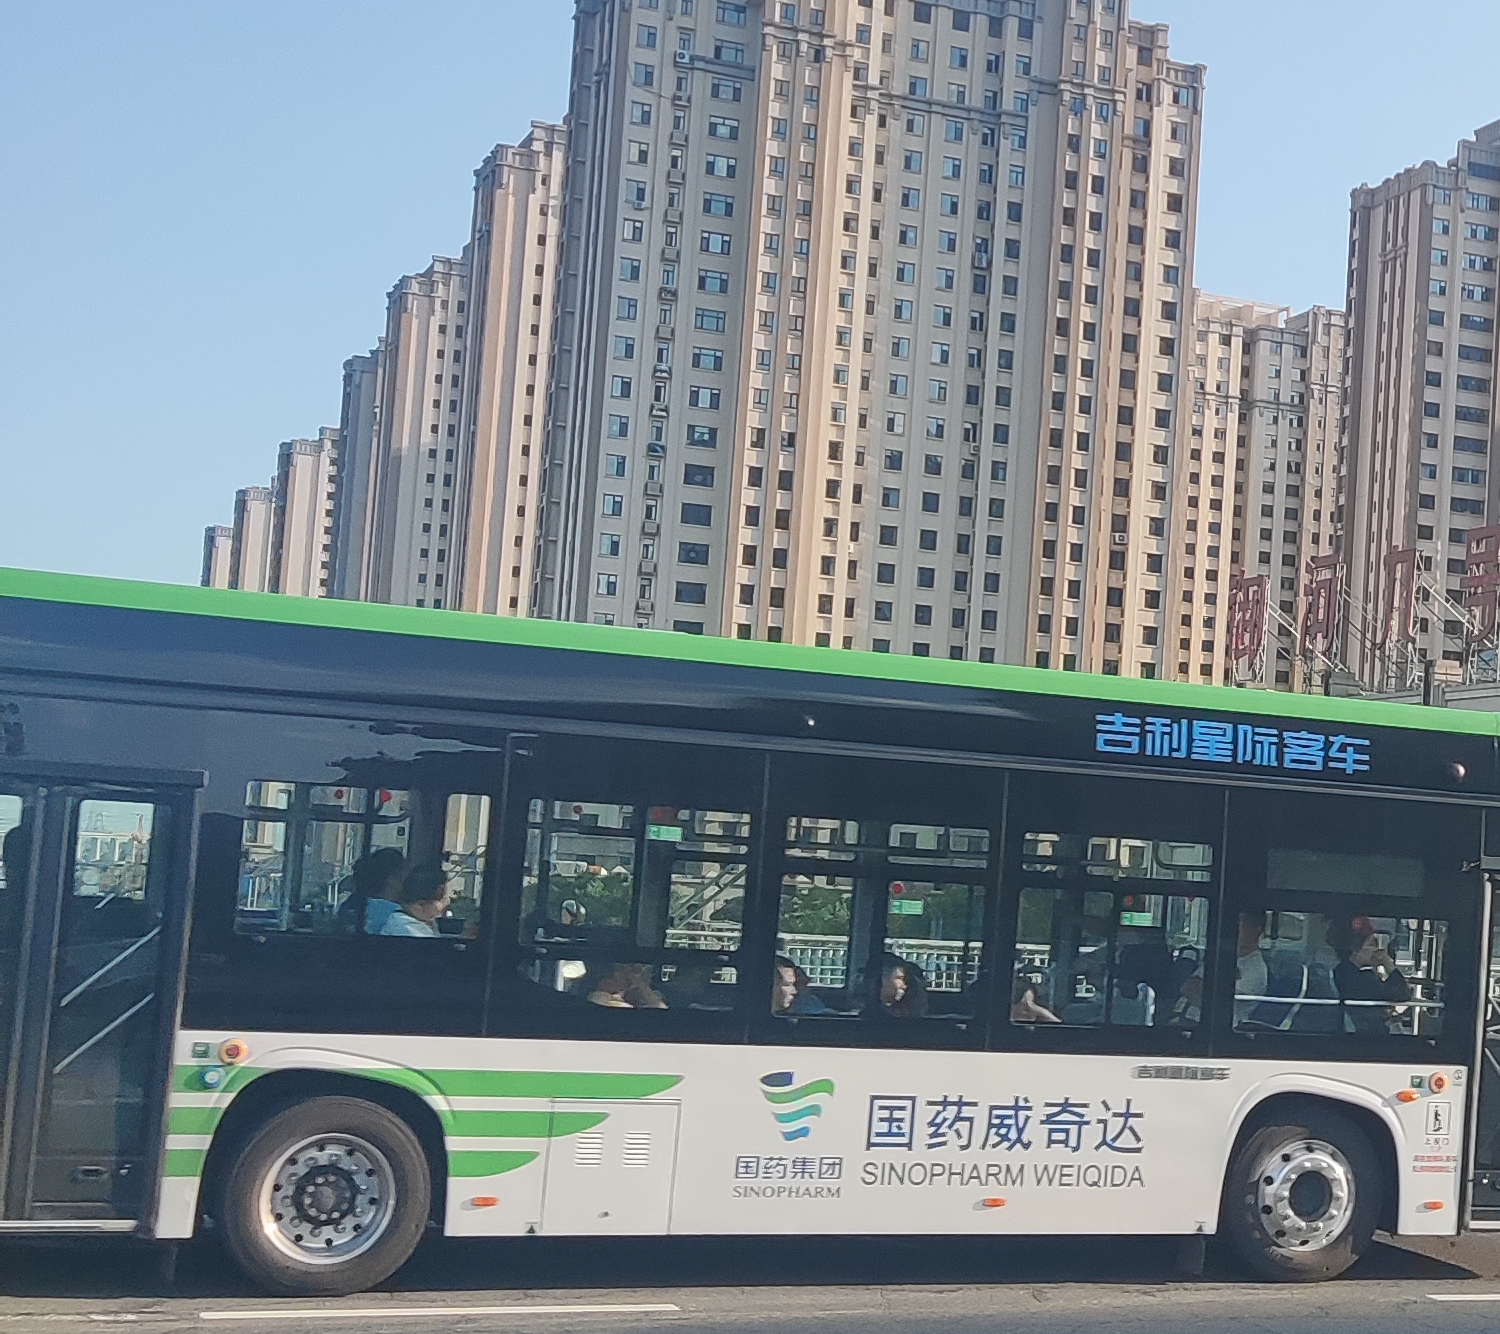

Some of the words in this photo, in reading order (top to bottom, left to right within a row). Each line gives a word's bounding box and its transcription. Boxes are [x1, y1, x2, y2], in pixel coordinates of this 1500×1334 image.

[1095, 712, 1371, 774] 吉利星际客车
[865, 1094, 1145, 1154] 国药威奇达
[735, 1155, 843, 1180] 国药集团
[861, 1161, 1026, 1188] SINOPHARM
[1033, 1163, 1146, 1189] WEIQIDA
[732, 1185, 841, 1199] SINOPHARM
